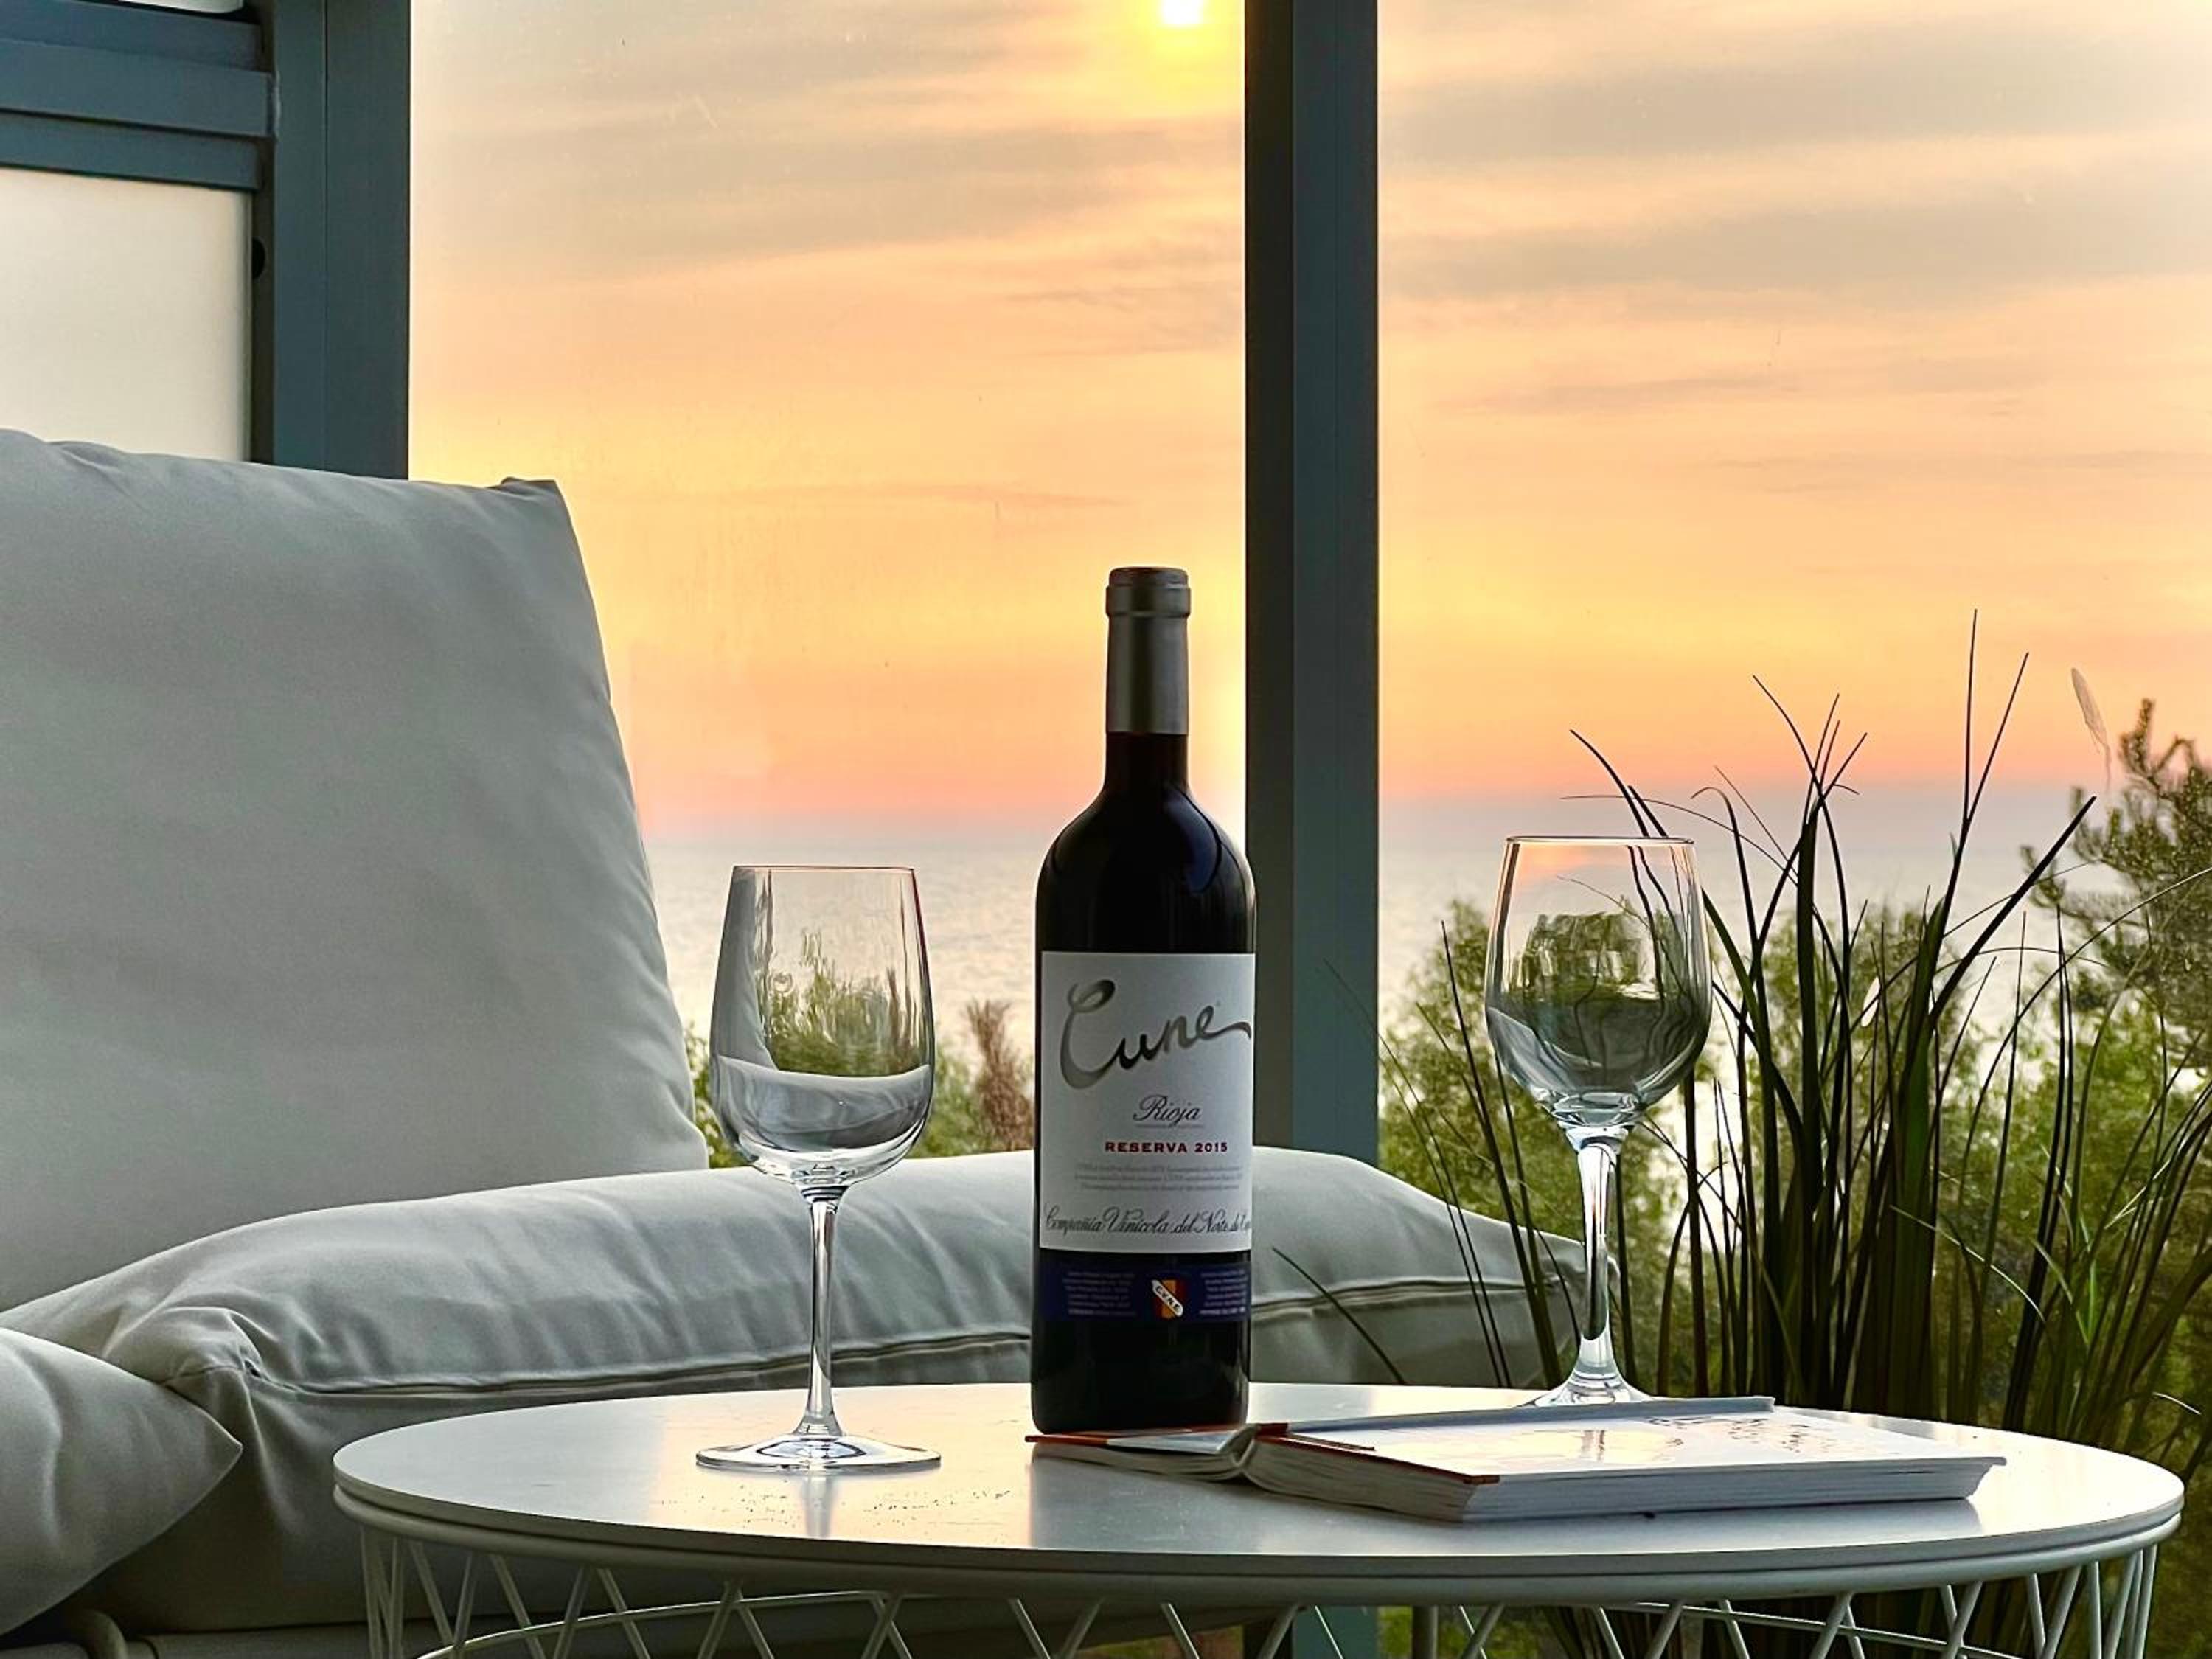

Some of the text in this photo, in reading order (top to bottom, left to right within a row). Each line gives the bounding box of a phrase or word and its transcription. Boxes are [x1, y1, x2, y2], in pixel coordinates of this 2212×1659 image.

[1132, 1094, 1202, 1127] Rioja
[1105, 1141, 1228, 1153] RESERVA 2015
